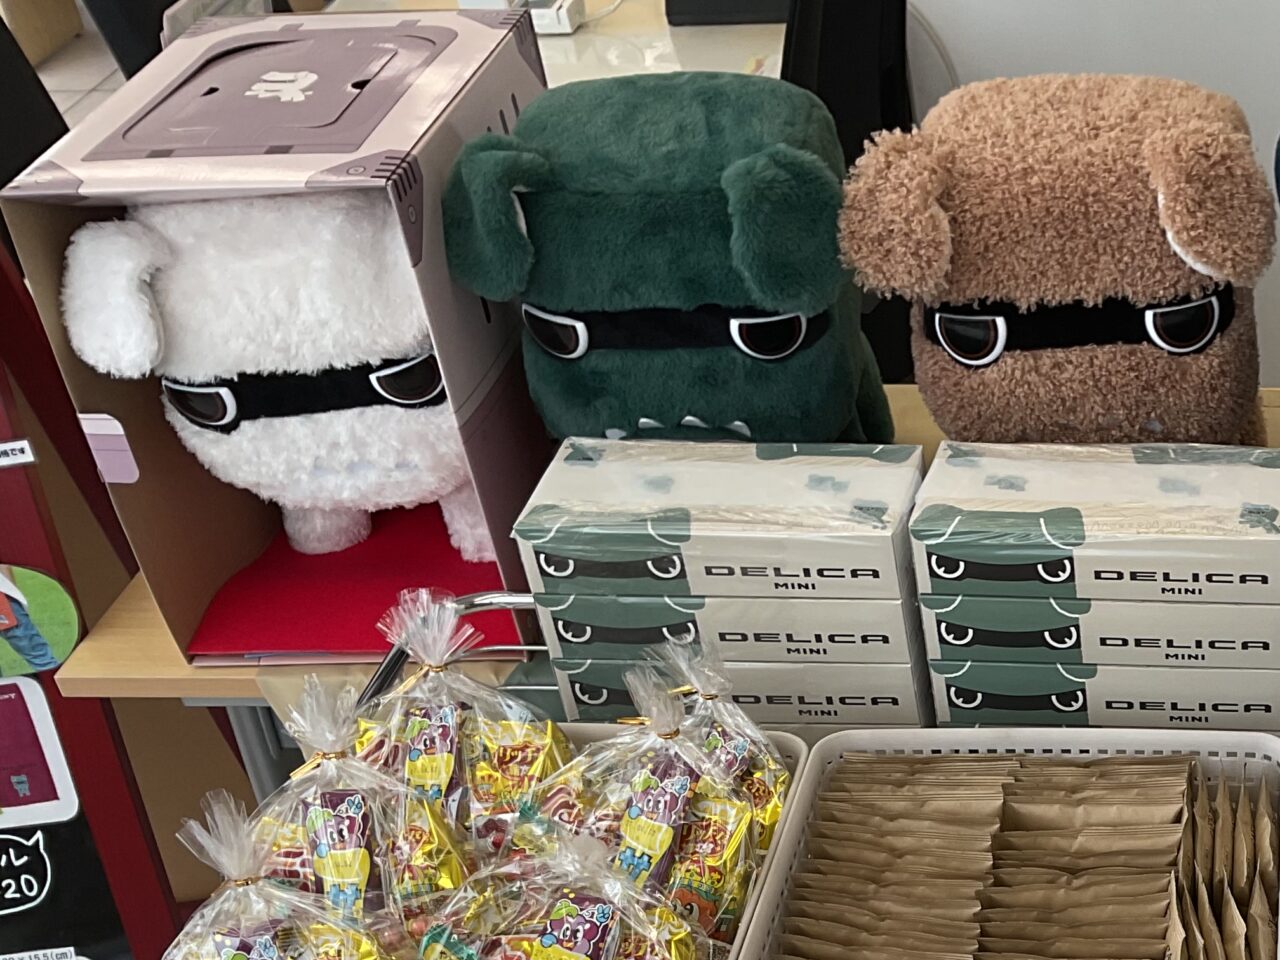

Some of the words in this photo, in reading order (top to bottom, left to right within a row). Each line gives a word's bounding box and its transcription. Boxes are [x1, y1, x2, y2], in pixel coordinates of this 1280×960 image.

[704, 565, 880, 580] DELICA
[1094, 569, 1269, 585] DELICA
[774, 582, 816, 591] MINI
[1161, 586, 1203, 596] MINI
[718, 631, 890, 645] DELICA
[1100, 636, 1271, 651] DELICA
[786, 647, 828, 656] MINI
[1165, 653, 1206, 662] MINI
[731, 694, 900, 707] DELICA
[1105, 699, 1273, 714] DELICA
[798, 709, 839, 718] MINI
[1169, 715, 1209, 724] MINI
